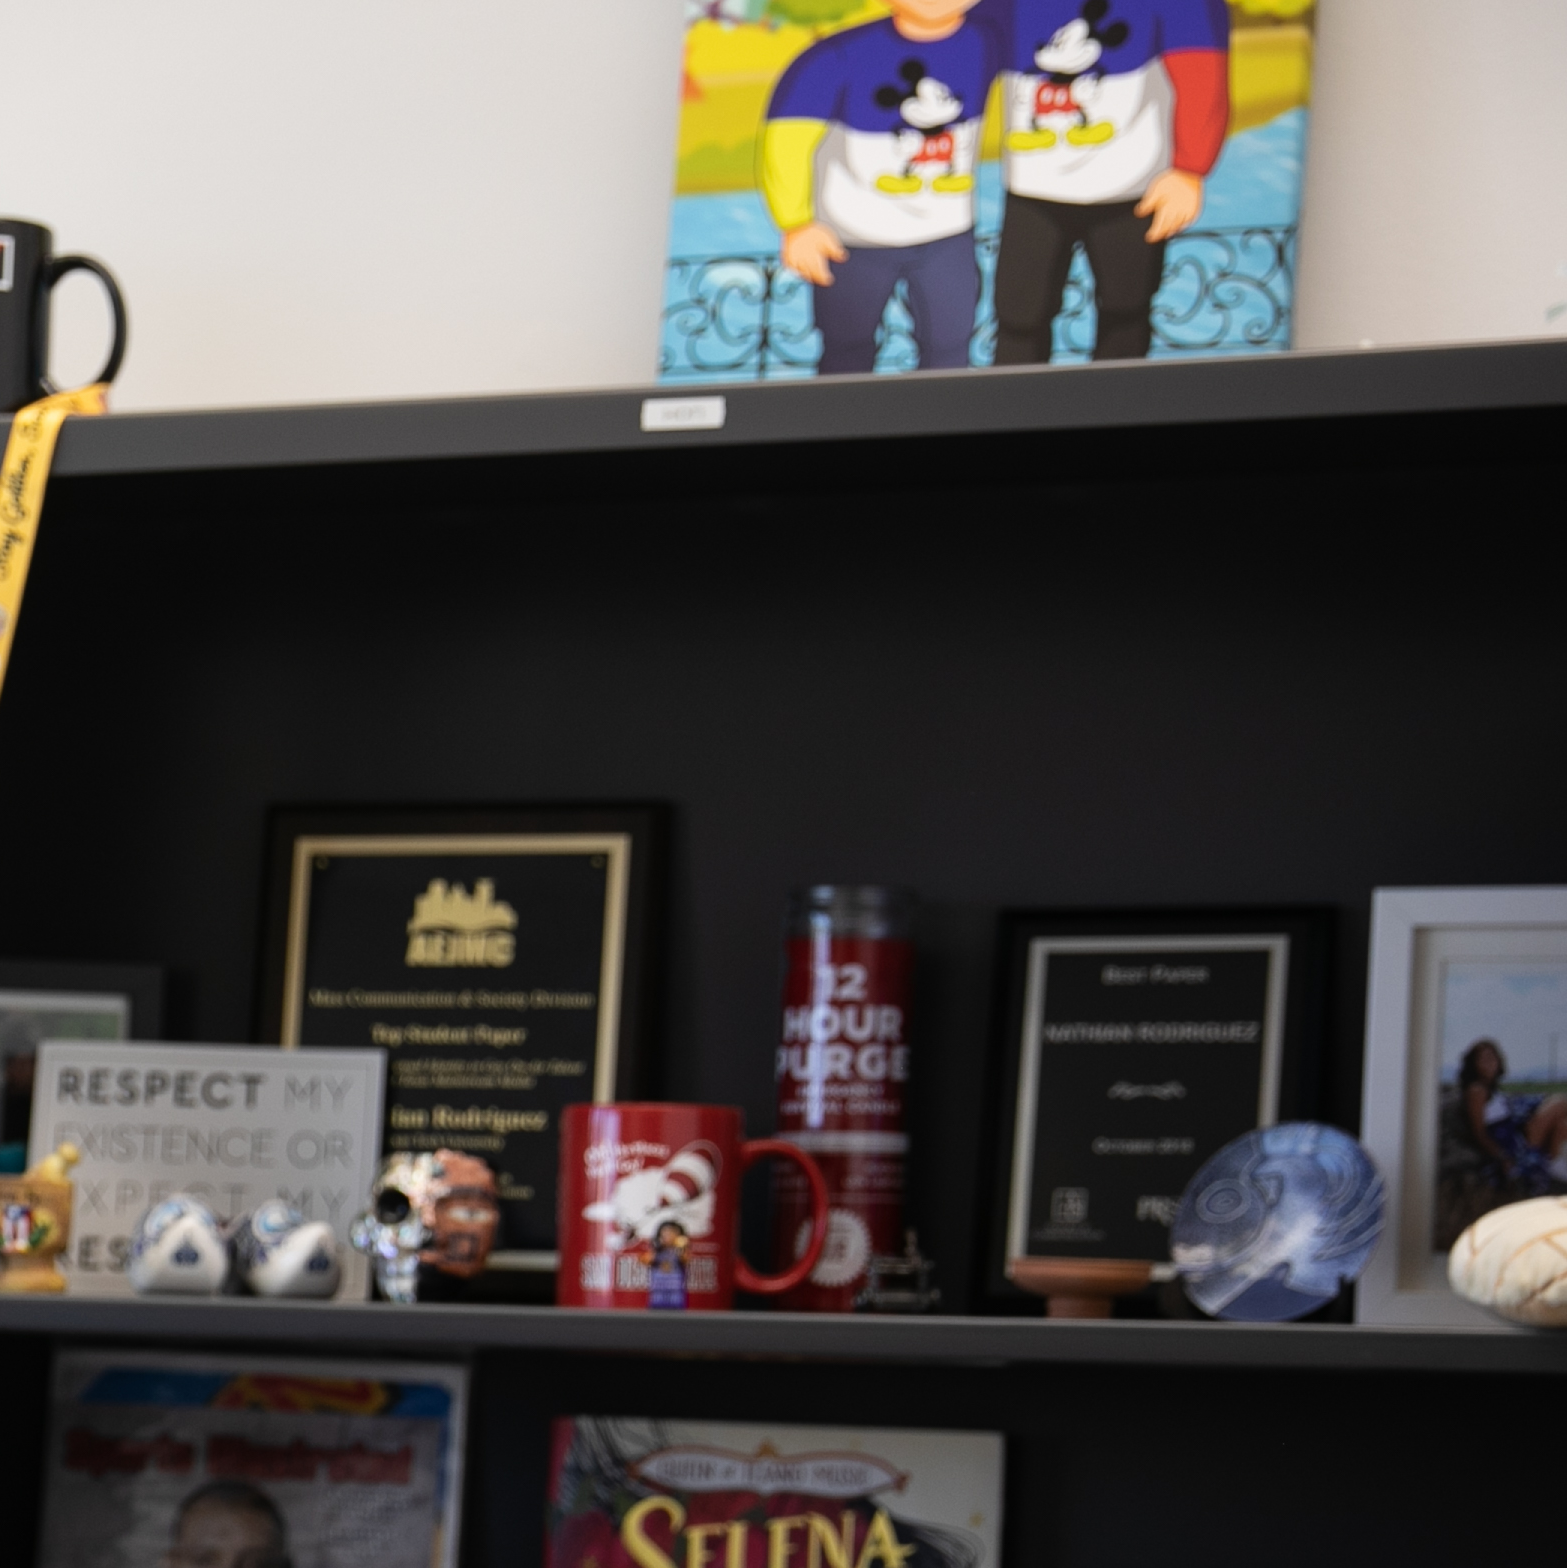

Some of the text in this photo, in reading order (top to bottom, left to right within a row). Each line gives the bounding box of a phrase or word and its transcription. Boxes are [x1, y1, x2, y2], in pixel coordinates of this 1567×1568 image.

[782, 1004, 905, 1041] HOUR
[56, 1066, 355, 1113] RESPECT MY
[53, 1120, 355, 1170] EXISTENCE OR
